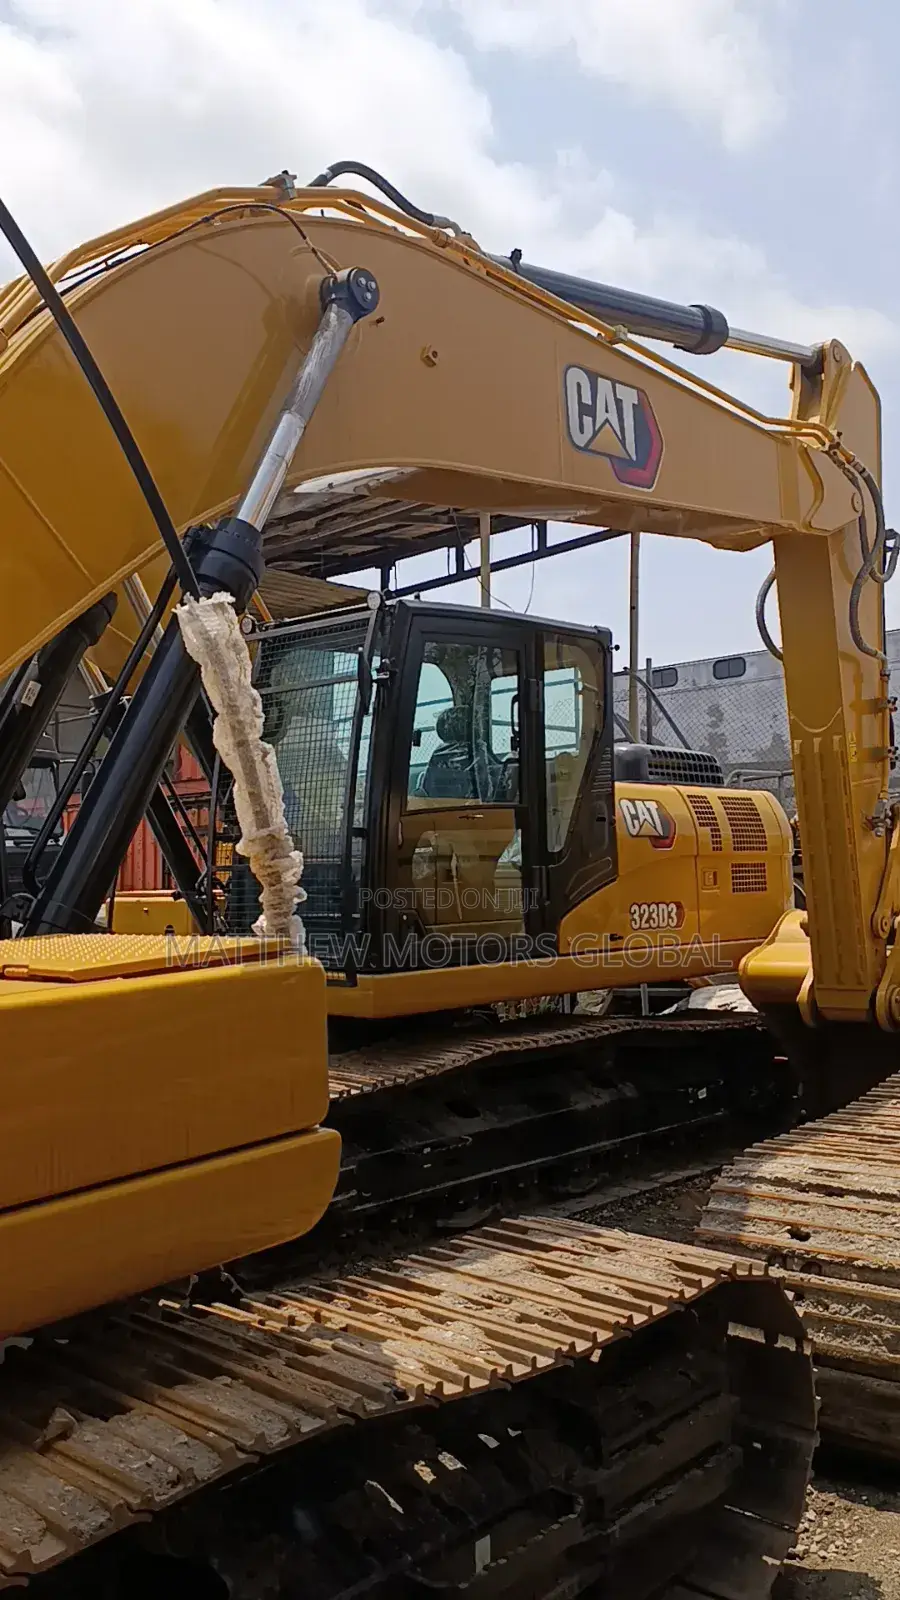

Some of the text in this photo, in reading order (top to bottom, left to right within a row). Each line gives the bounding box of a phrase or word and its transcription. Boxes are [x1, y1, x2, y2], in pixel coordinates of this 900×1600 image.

[566, 367, 638, 461] CAT
[619, 800, 664, 837] CAT
[630, 902, 678, 930] 323D3
